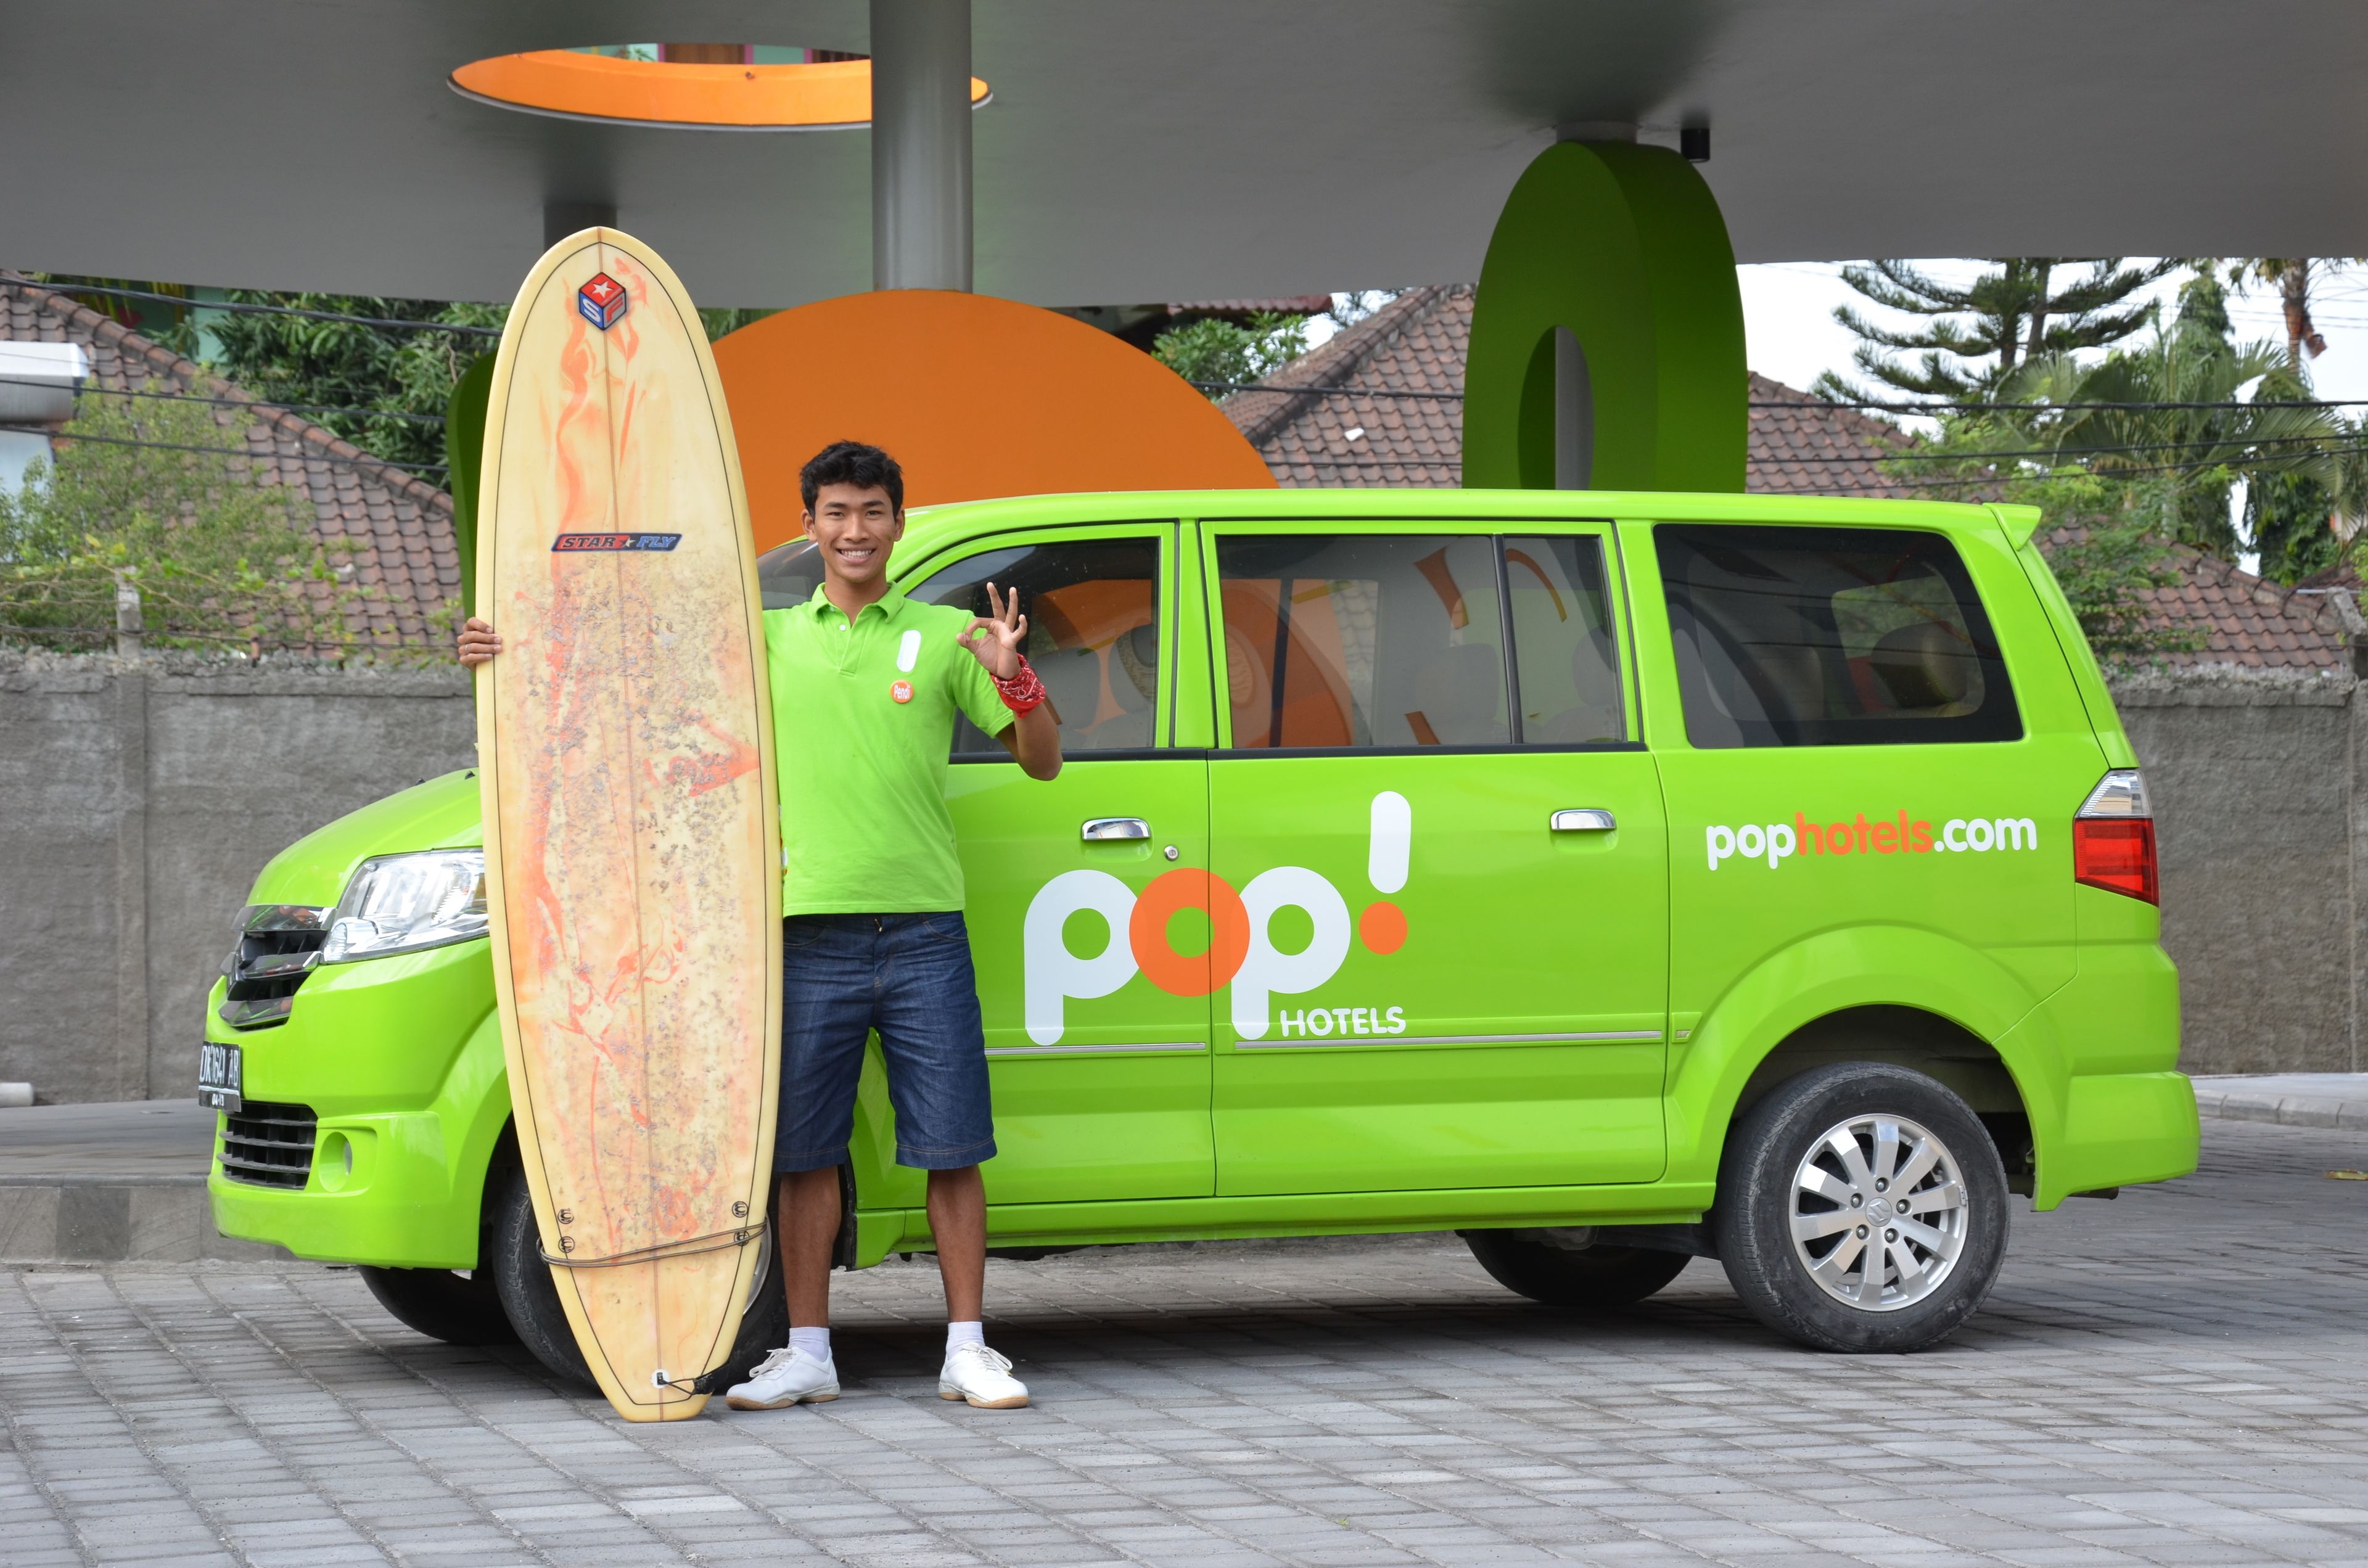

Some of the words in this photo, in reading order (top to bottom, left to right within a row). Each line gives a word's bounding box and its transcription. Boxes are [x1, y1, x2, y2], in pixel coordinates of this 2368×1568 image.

[562, 536, 617, 548] STAR
[636, 536, 676, 548] FLY
[894, 684, 911, 700] Pendi
[1706, 808, 2037, 871] pophotels.com
[1279, 1006, 1406, 1037] HOTELS
[228, 1049, 239, 1087] AB
